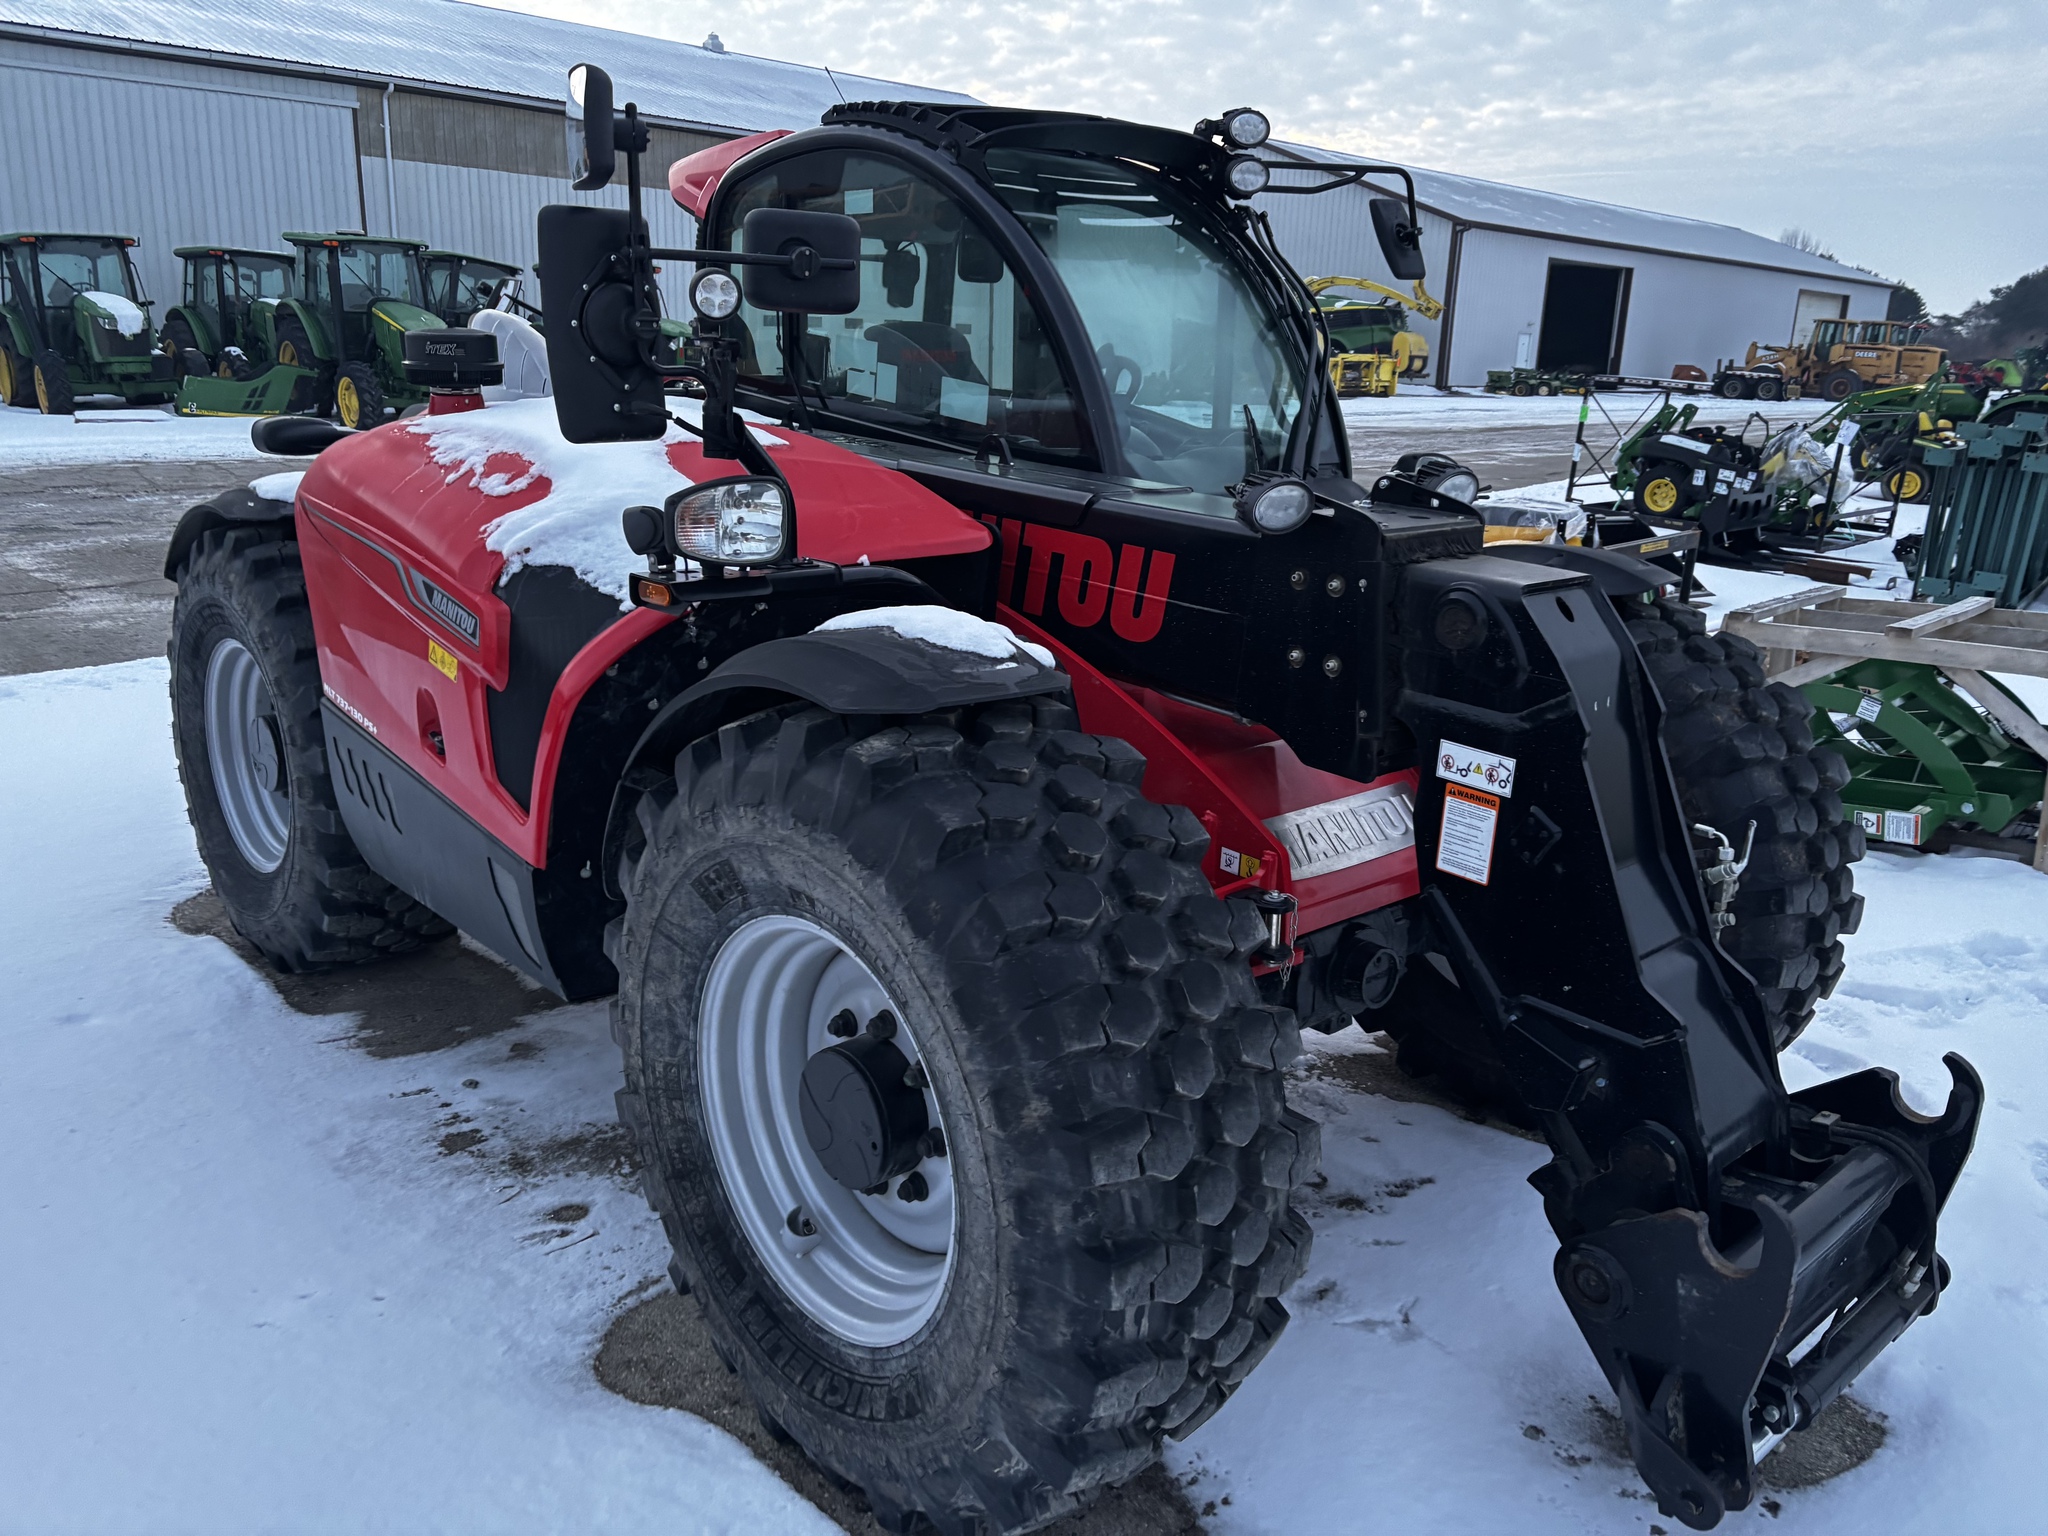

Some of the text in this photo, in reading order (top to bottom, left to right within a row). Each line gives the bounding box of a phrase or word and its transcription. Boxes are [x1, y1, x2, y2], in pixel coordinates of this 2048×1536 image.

[1854, 350, 1878, 359] DEERE
[962, 509, 1176, 643] ITOU
[431, 590, 476, 635] MANITOU
[323, 682, 336, 699] MLT
[335, 693, 363, 723] 737-130
[1457, 788, 1497, 808] WARNING
